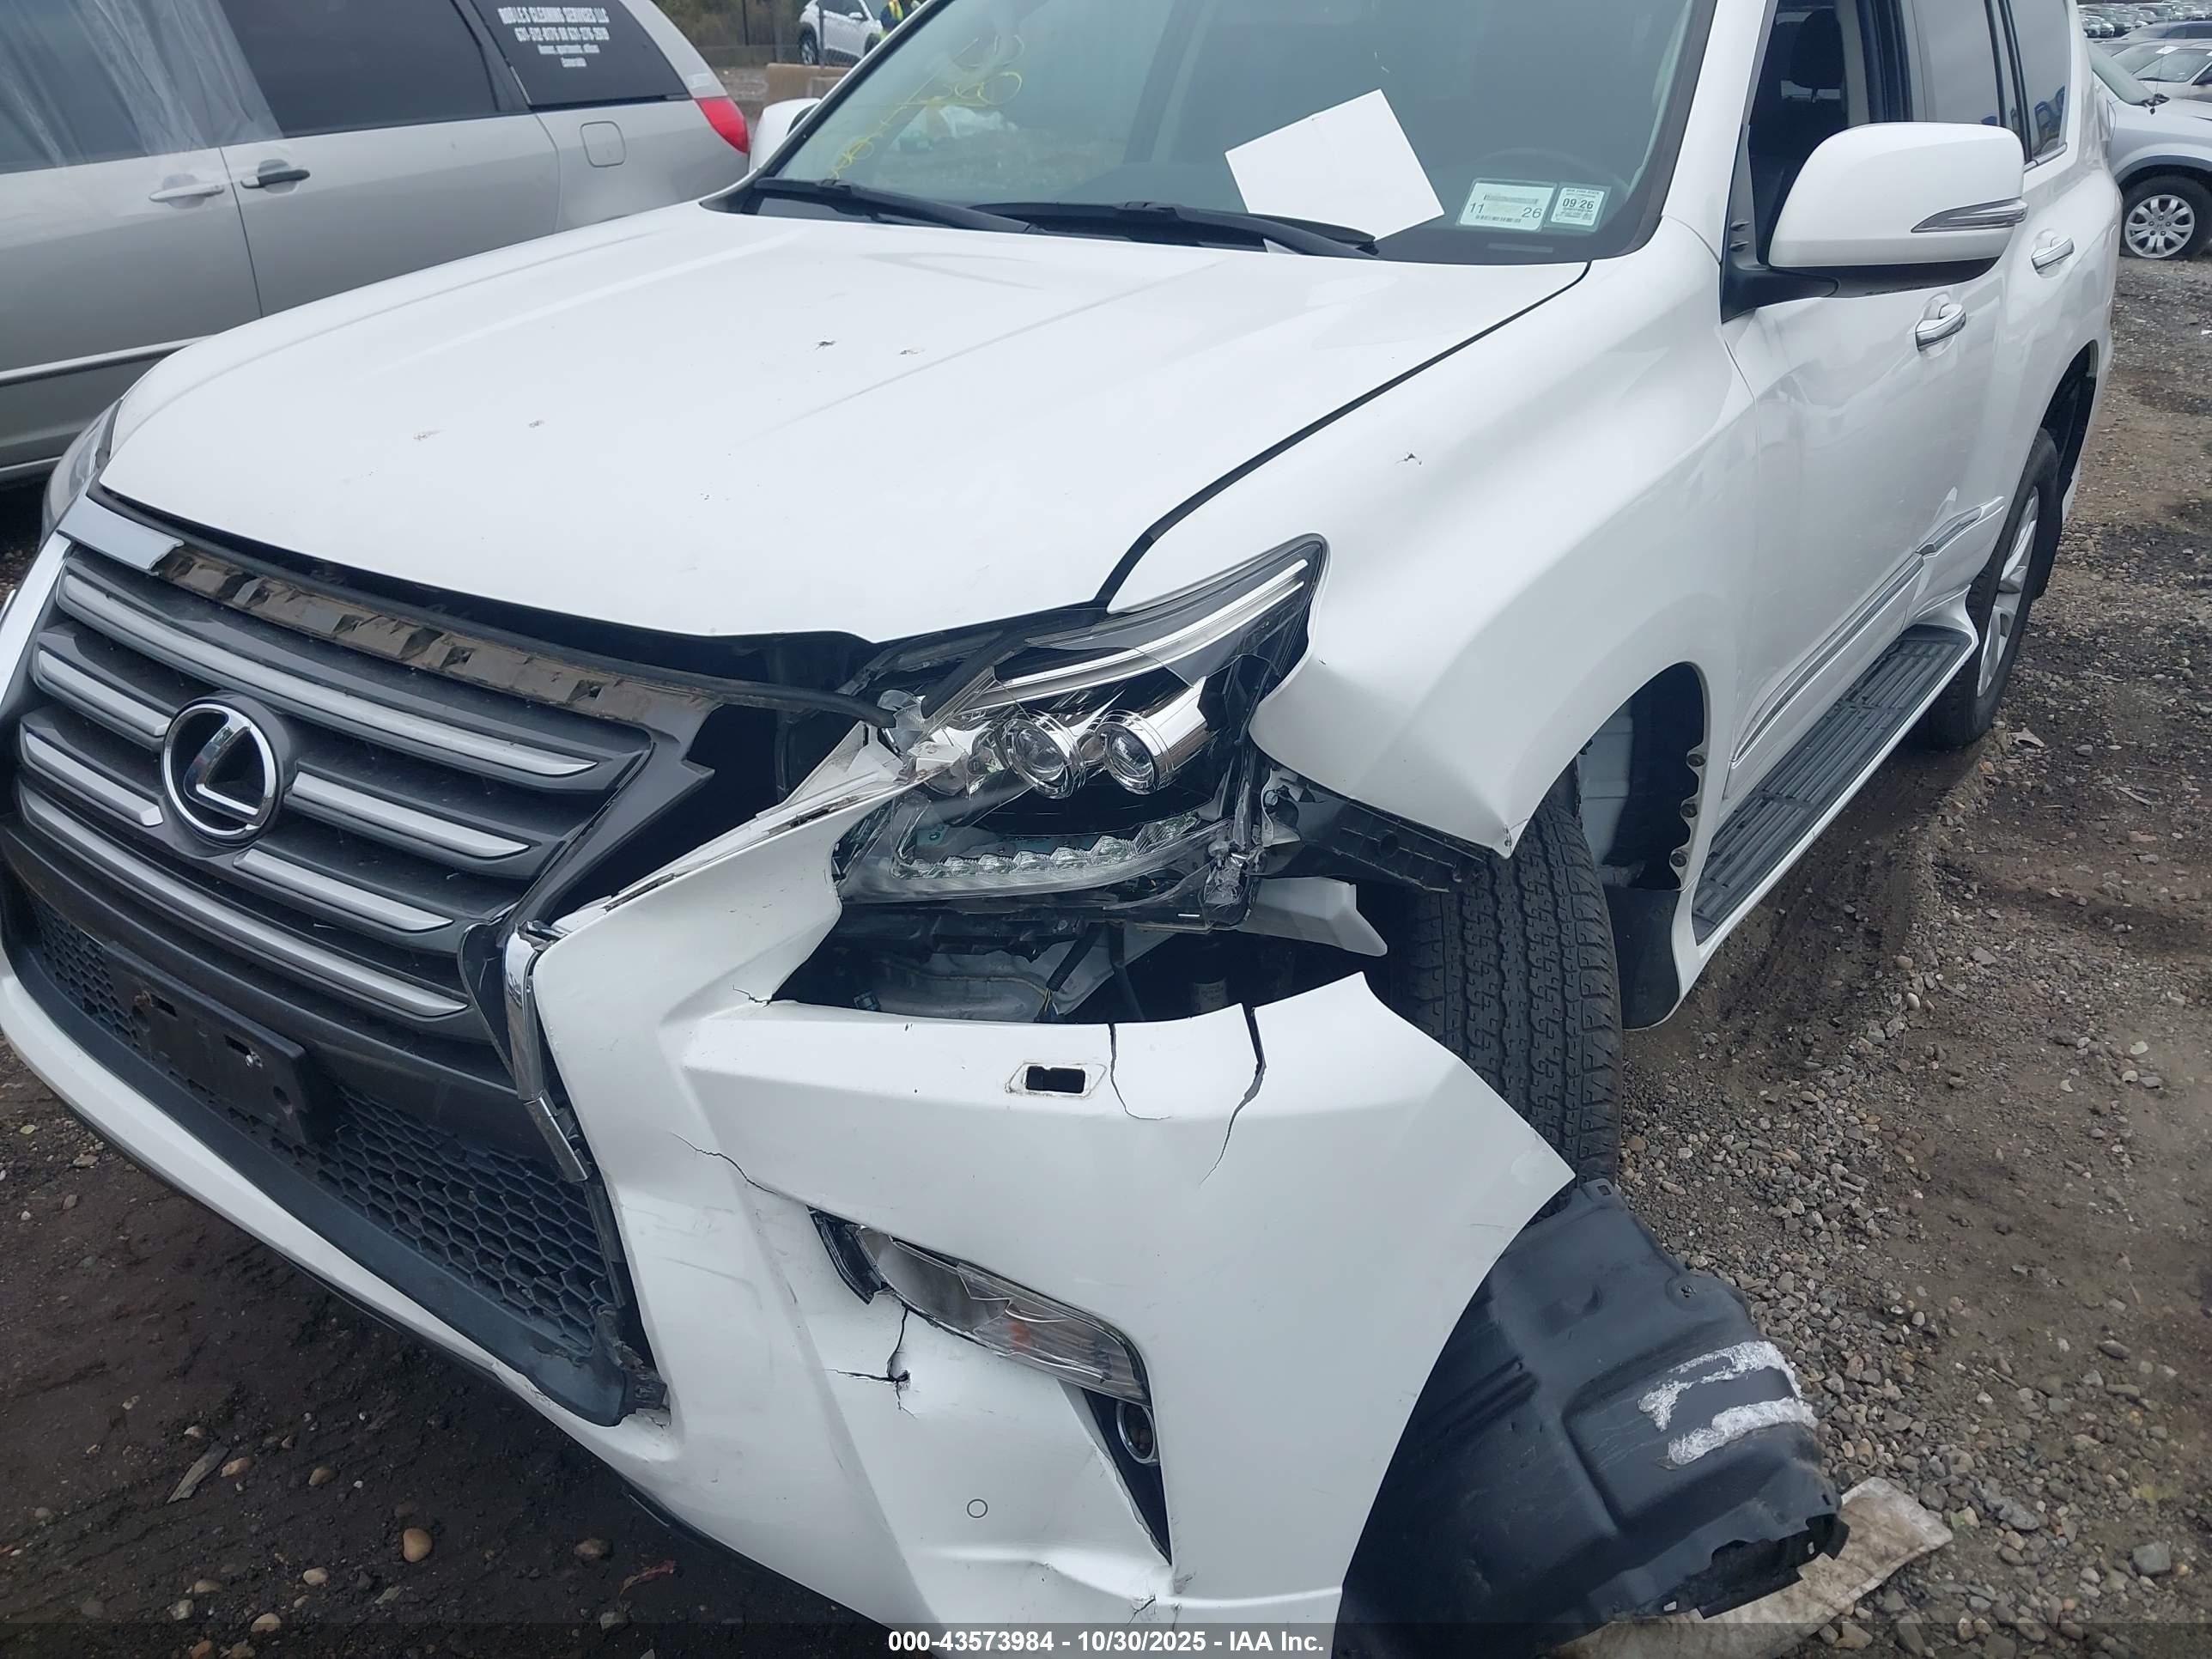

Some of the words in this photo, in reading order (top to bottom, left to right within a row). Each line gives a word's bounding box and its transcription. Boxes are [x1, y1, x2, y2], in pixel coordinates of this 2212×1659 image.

[1469, 202, 1485, 215] 11
[1521, 207, 1543, 220] 26
[1562, 198, 1577, 209] 09
[1577, 199, 1595, 210] 26
